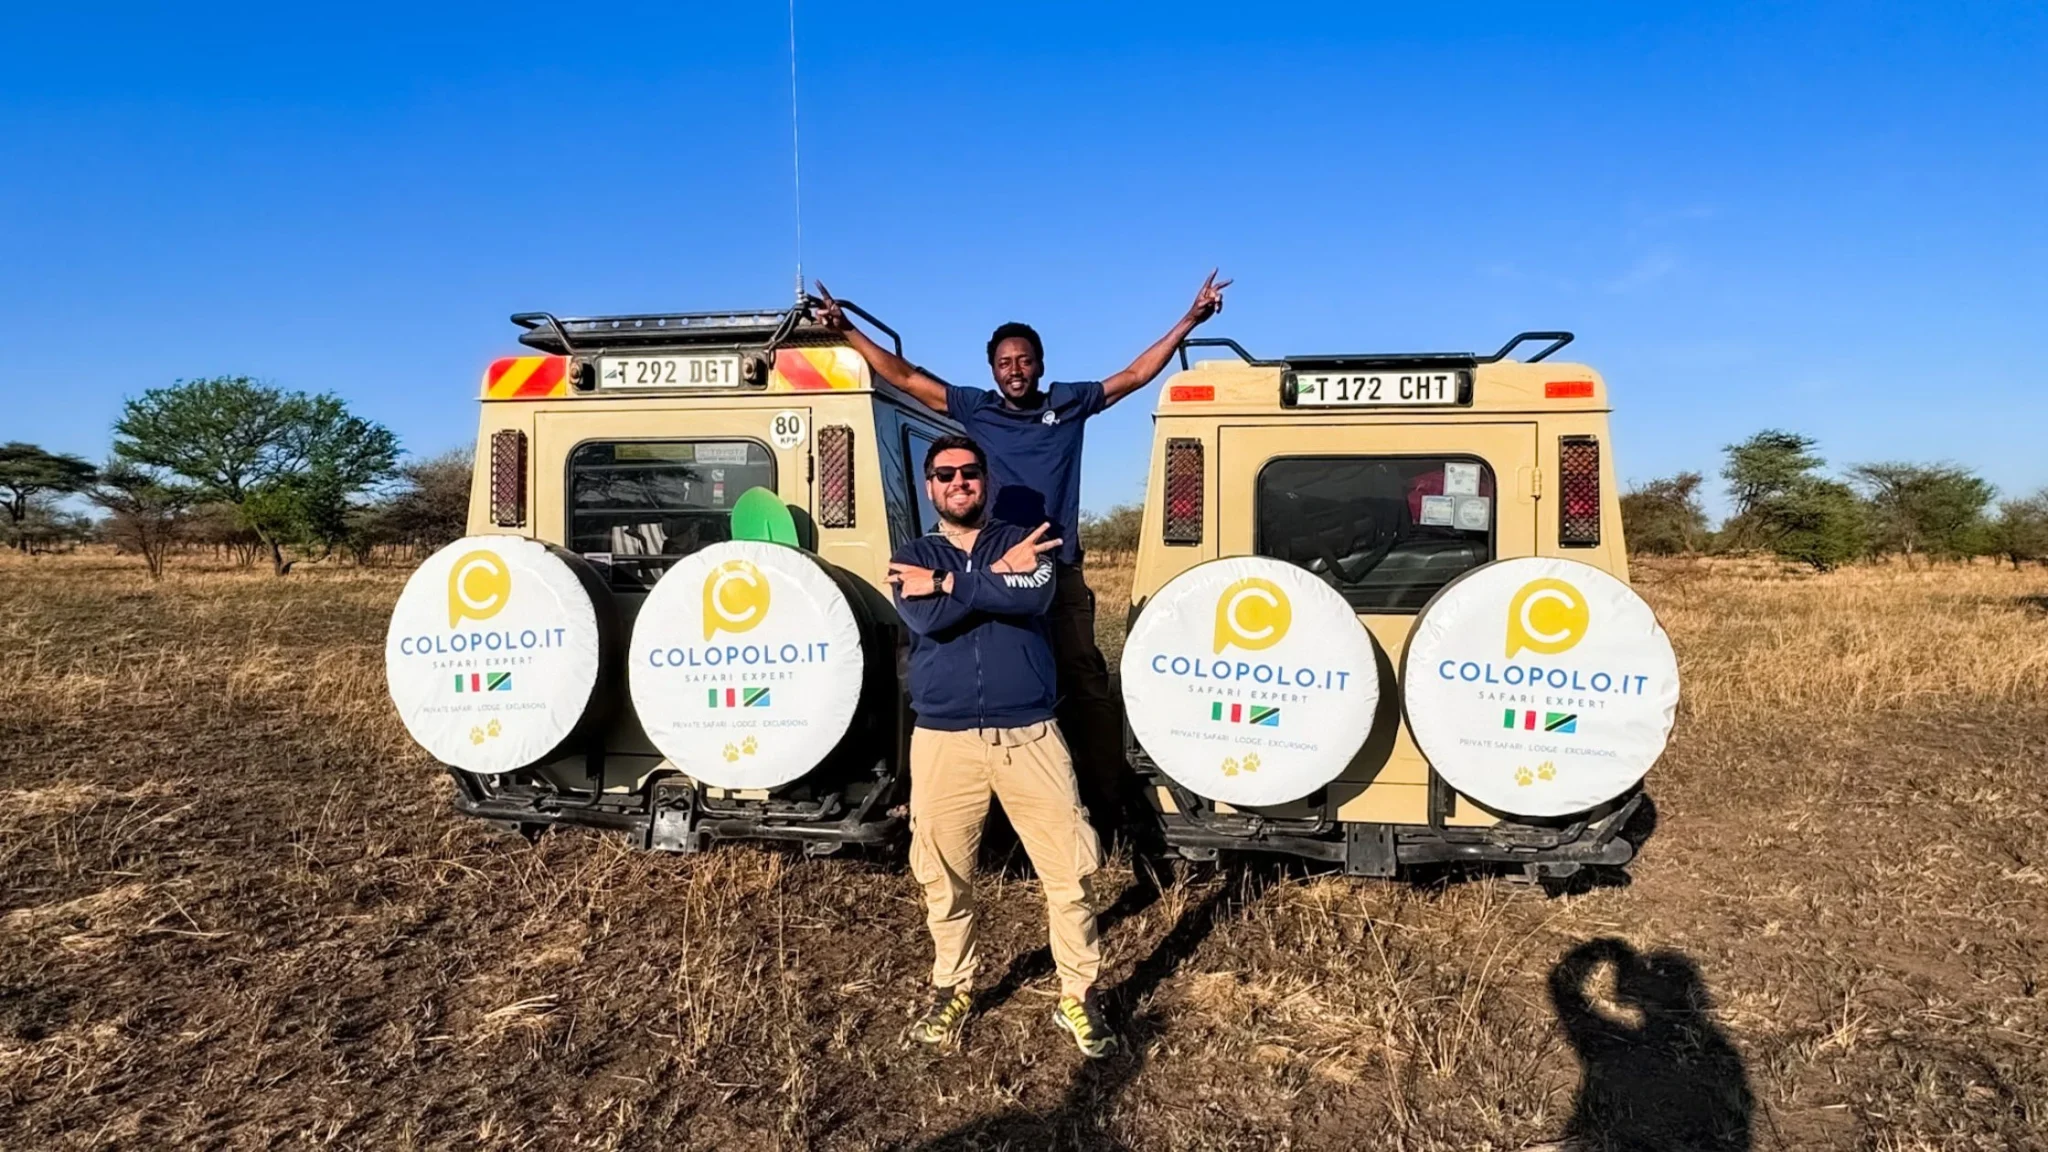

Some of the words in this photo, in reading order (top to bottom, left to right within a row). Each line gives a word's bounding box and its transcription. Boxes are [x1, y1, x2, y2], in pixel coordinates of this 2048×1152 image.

[617, 361, 629, 384] T
[637, 360, 677, 384] 292
[689, 359, 733, 384] DGT
[1315, 377, 1328, 401] T
[1336, 376, 1382, 401] 172
[1399, 375, 1448, 400] CHT
[775, 415, 800, 436] 80
[780, 437, 798, 445] KPH
[400, 628, 566, 656] COLOPOLO.IT
[432, 659, 478, 670] SAFARI
[486, 656, 534, 667] EXPERT
[649, 643, 829, 668] COLOPOLO.IT
[685, 673, 733, 683] SAFARI
[742, 671, 794, 681] EXPERT
[1152, 655, 1350, 691] COLOPOLO.IT
[1439, 660, 1648, 695] COLOPOLO.IT
[1188, 684, 1241, 698] SAFARI
[1251, 690, 1309, 704] EXPERT
[1478, 690, 1535, 704] SAFARI
[1546, 696, 1606, 709] EXPERT
[672, 721, 700, 729] PRIVATE
[702, 720, 727, 728] SAFARI
[732, 720, 757, 728] LODGE
[1170, 729, 1200, 739] PRIVATE
[1203, 732, 1229, 741] SAFARI
[1235, 735, 1262, 746] LODGE
[1459, 738, 1492, 748] PRIVATE
[1494, 740, 1523, 750] SAFARI
[1528, 743, 1558, 754] LODGE
